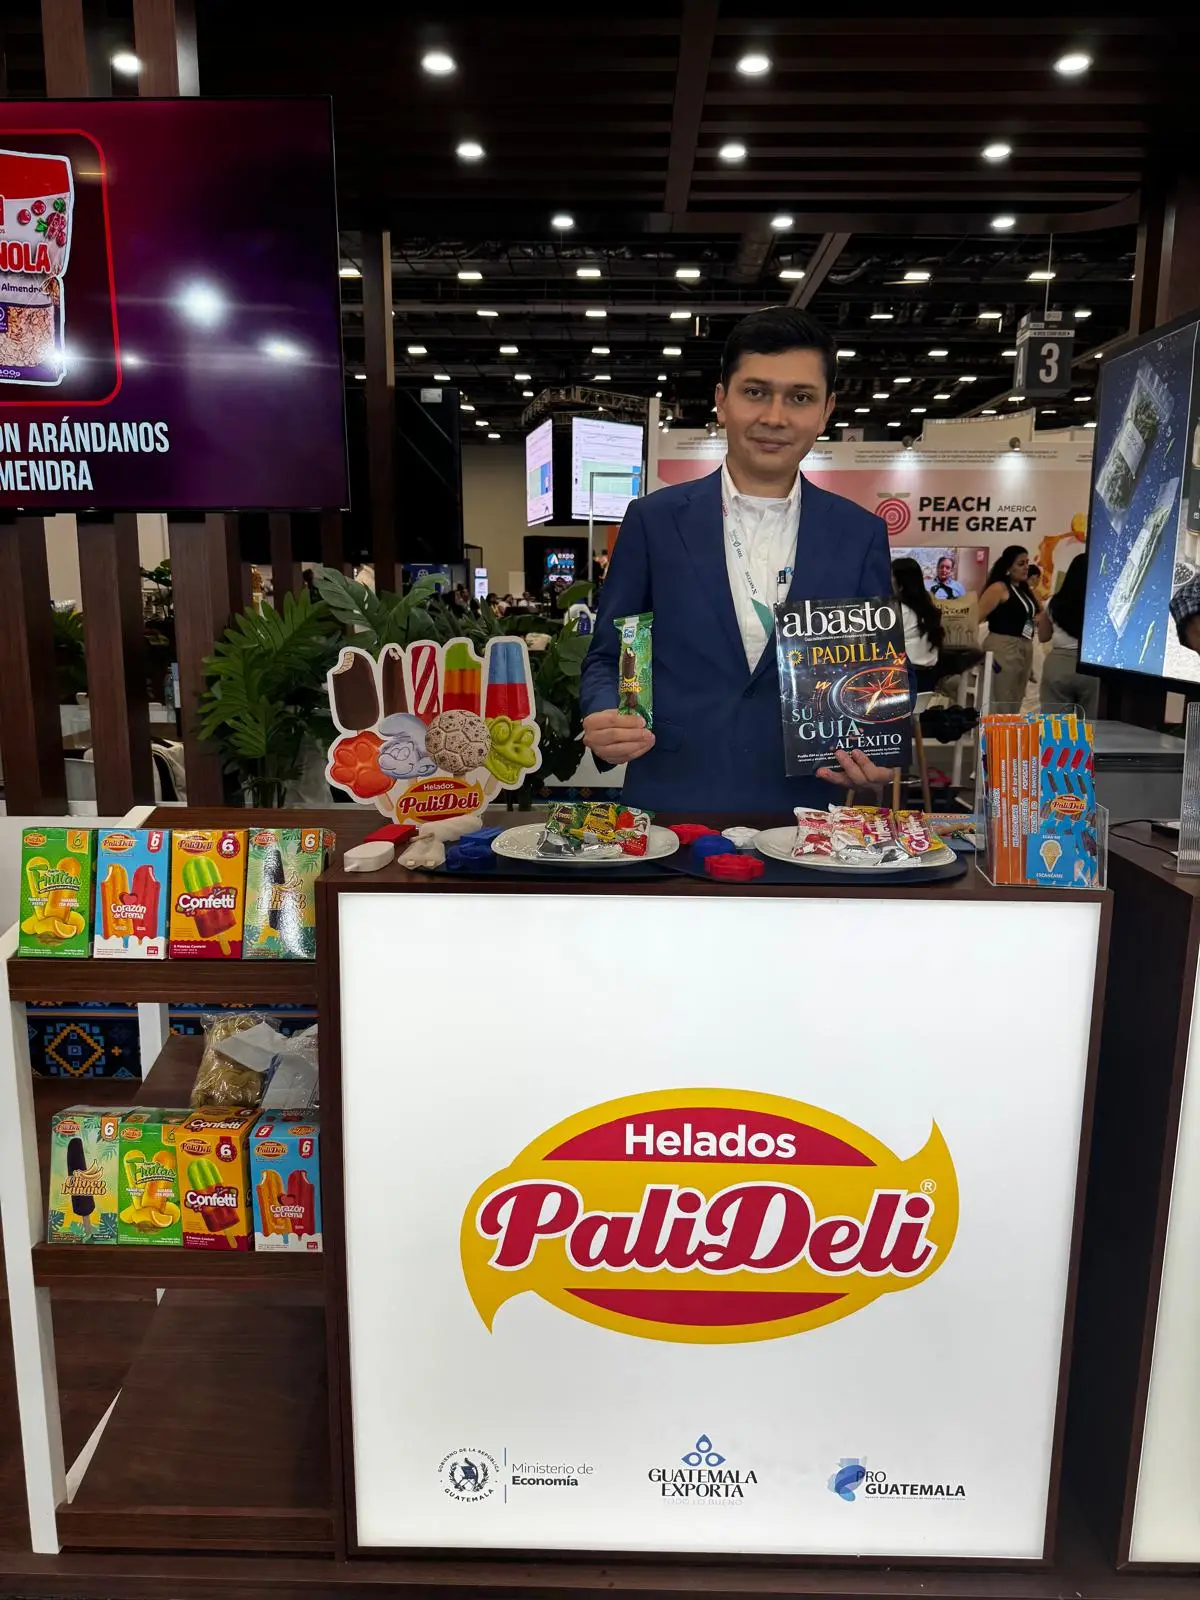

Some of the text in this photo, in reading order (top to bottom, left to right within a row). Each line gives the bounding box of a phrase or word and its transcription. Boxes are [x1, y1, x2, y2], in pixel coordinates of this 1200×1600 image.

[1039, 342, 1060, 383] 3
[28, 416, 170, 453] ARÁNDANOS
[919, 496, 1037, 513] PEACH AMERICA
[918, 516, 1037, 532] THE GREAT
[782, 600, 896, 638] abasto
[811, 641, 899, 666] PADILLA
[792, 708, 813, 722] SU
[798, 715, 862, 740] GUÍA
[835, 732, 902, 749] AL ÉXITO
[423, 782, 455, 791] Helados
[398, 792, 480, 815] PaliDeli
[73, 831, 83, 847] 6
[150, 831, 161, 847] 6
[222, 838, 235, 851] 6
[304, 833, 317, 847] 6
[110, 903, 147, 914] Corazón
[178, 894, 235, 909] Confetti
[120, 911, 144, 920] Crema
[104, 1122, 115, 1136] 6
[190, 1119, 242, 1129] Confetti
[302, 1140, 312, 1153] 6
[624, 1122, 797, 1159] Helados
[220, 1143, 232, 1156] 6
[186, 1191, 237, 1208] Confetti
[270, 1204, 305, 1214] Corazón
[280, 1211, 303, 1219] Crema
[475, 1178, 938, 1279] PaliDeli
[437, 1450, 458, 1472] GOBIERNO
[477, 1449, 500, 1473] REPÚBLICA
[512, 1463, 594, 1475] Ministerio de
[648, 1468, 758, 1484] GUATEMALA
[856, 1470, 887, 1483] PRO
[511, 1475, 579, 1487] Economía
[444, 1488, 495, 1503] GUATEMALA
[661, 1483, 745, 1498] EXPORTA
[865, 1483, 966, 1497] GUATEMALA
